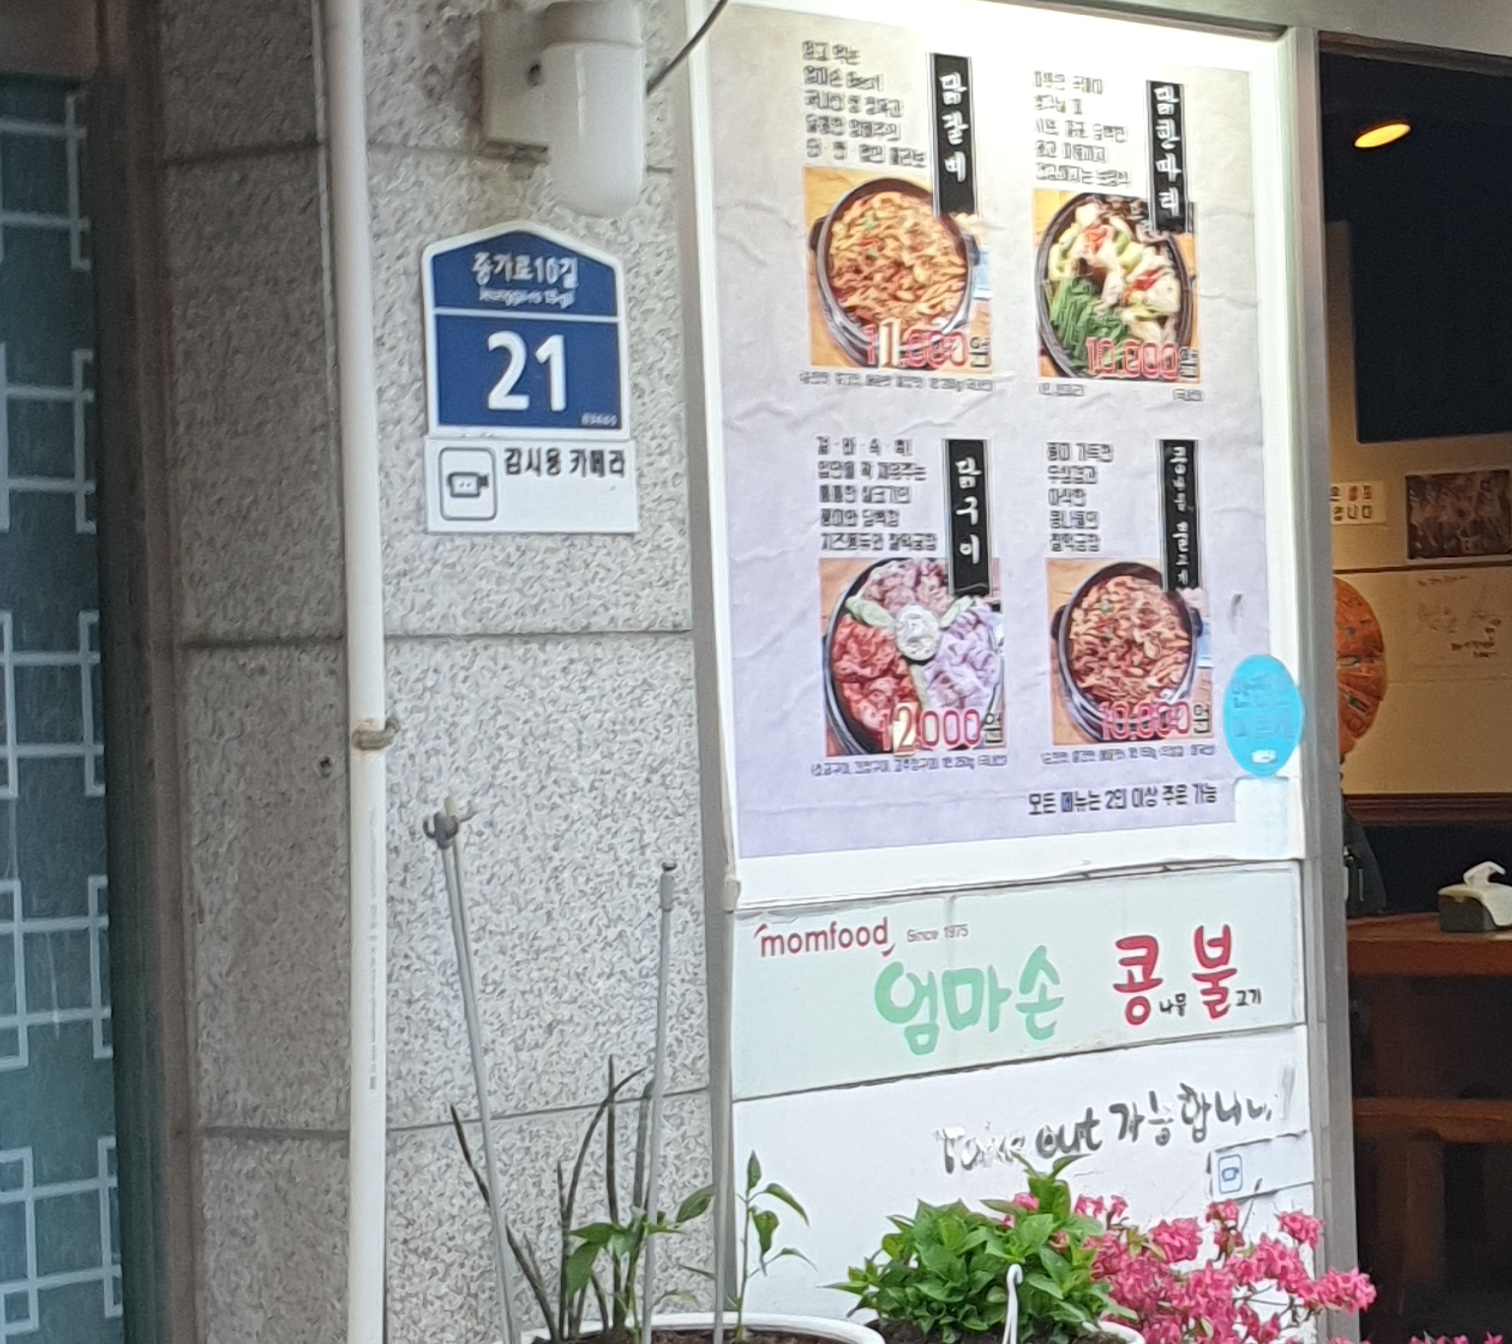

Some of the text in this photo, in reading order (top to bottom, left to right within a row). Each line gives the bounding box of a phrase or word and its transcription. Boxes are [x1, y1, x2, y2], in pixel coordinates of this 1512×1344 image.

[487, 330, 567, 413] 21
[569, 447, 626, 478] 카메라
[758, 915, 891, 958] momfood
[874, 944, 1065, 1057] 엄마손
